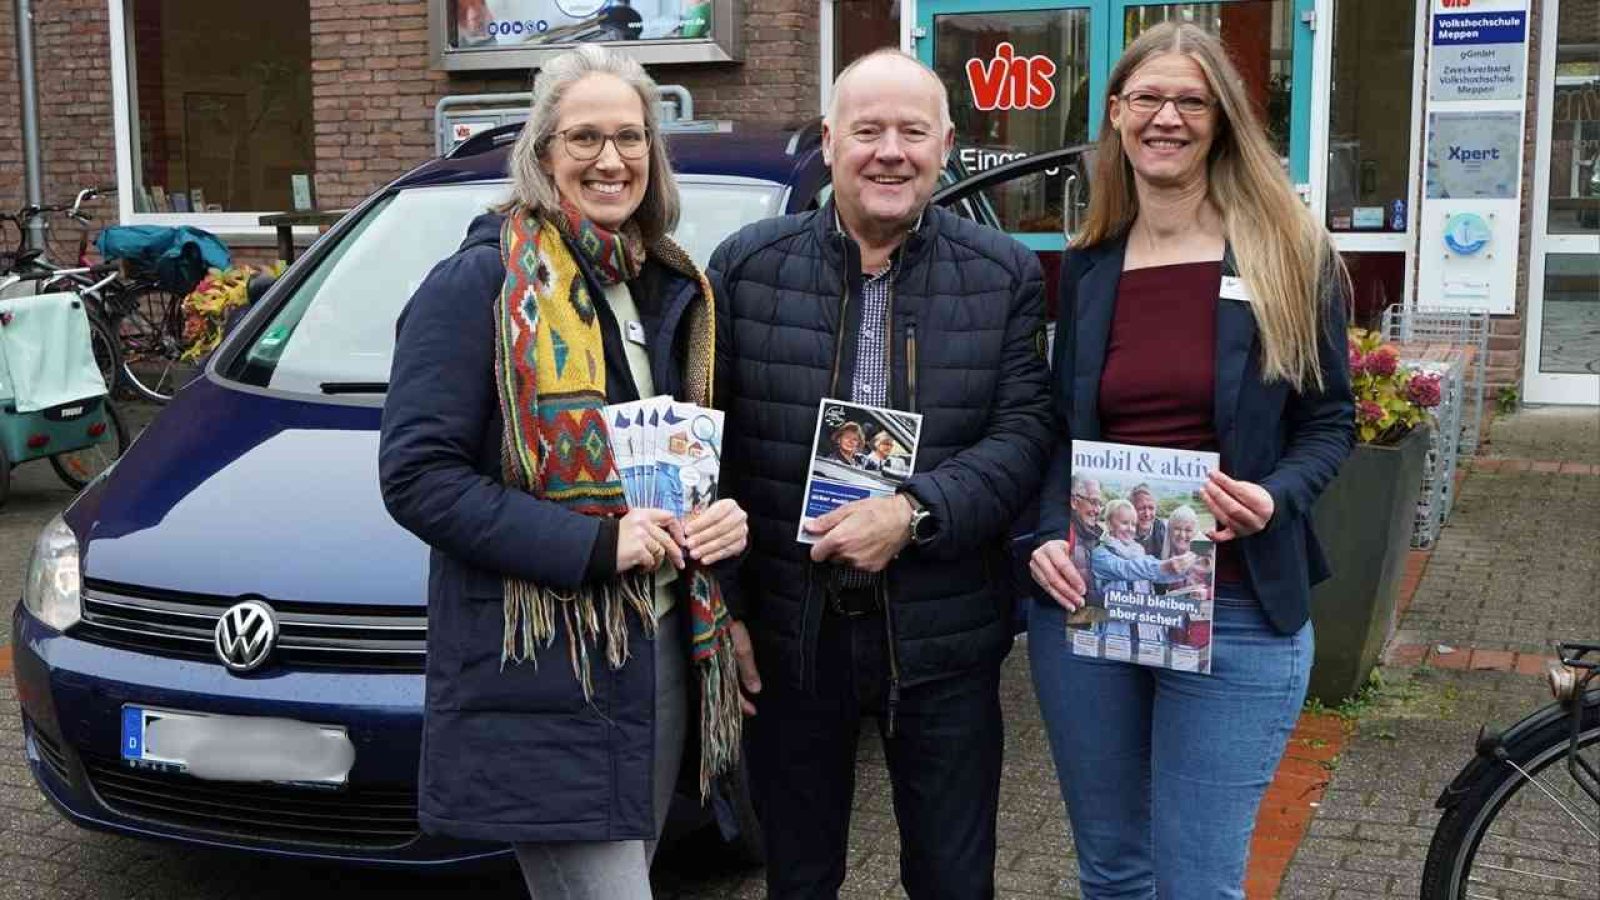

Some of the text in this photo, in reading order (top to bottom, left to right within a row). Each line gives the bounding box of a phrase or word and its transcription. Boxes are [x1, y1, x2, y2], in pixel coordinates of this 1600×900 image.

[1439, 16, 1521, 28] Volkshochschule
[1439, 30, 1479, 40] Meppen
[1460, 49, 1496, 60] gGmbH
[966, 41, 1056, 110] vhs
[1443, 65, 1511, 74] Zweckverband
[1440, 75, 1514, 84] Volkshochschule
[1457, 86, 1495, 94] Meppen
[1449, 146, 1500, 163] Xpert
[1075, 449, 1132, 471] mobil
[1137, 452, 1154, 473] &
[1109, 590, 1199, 614] Mobil bleiben,
[1109, 607, 1182, 627] aber sicher!
